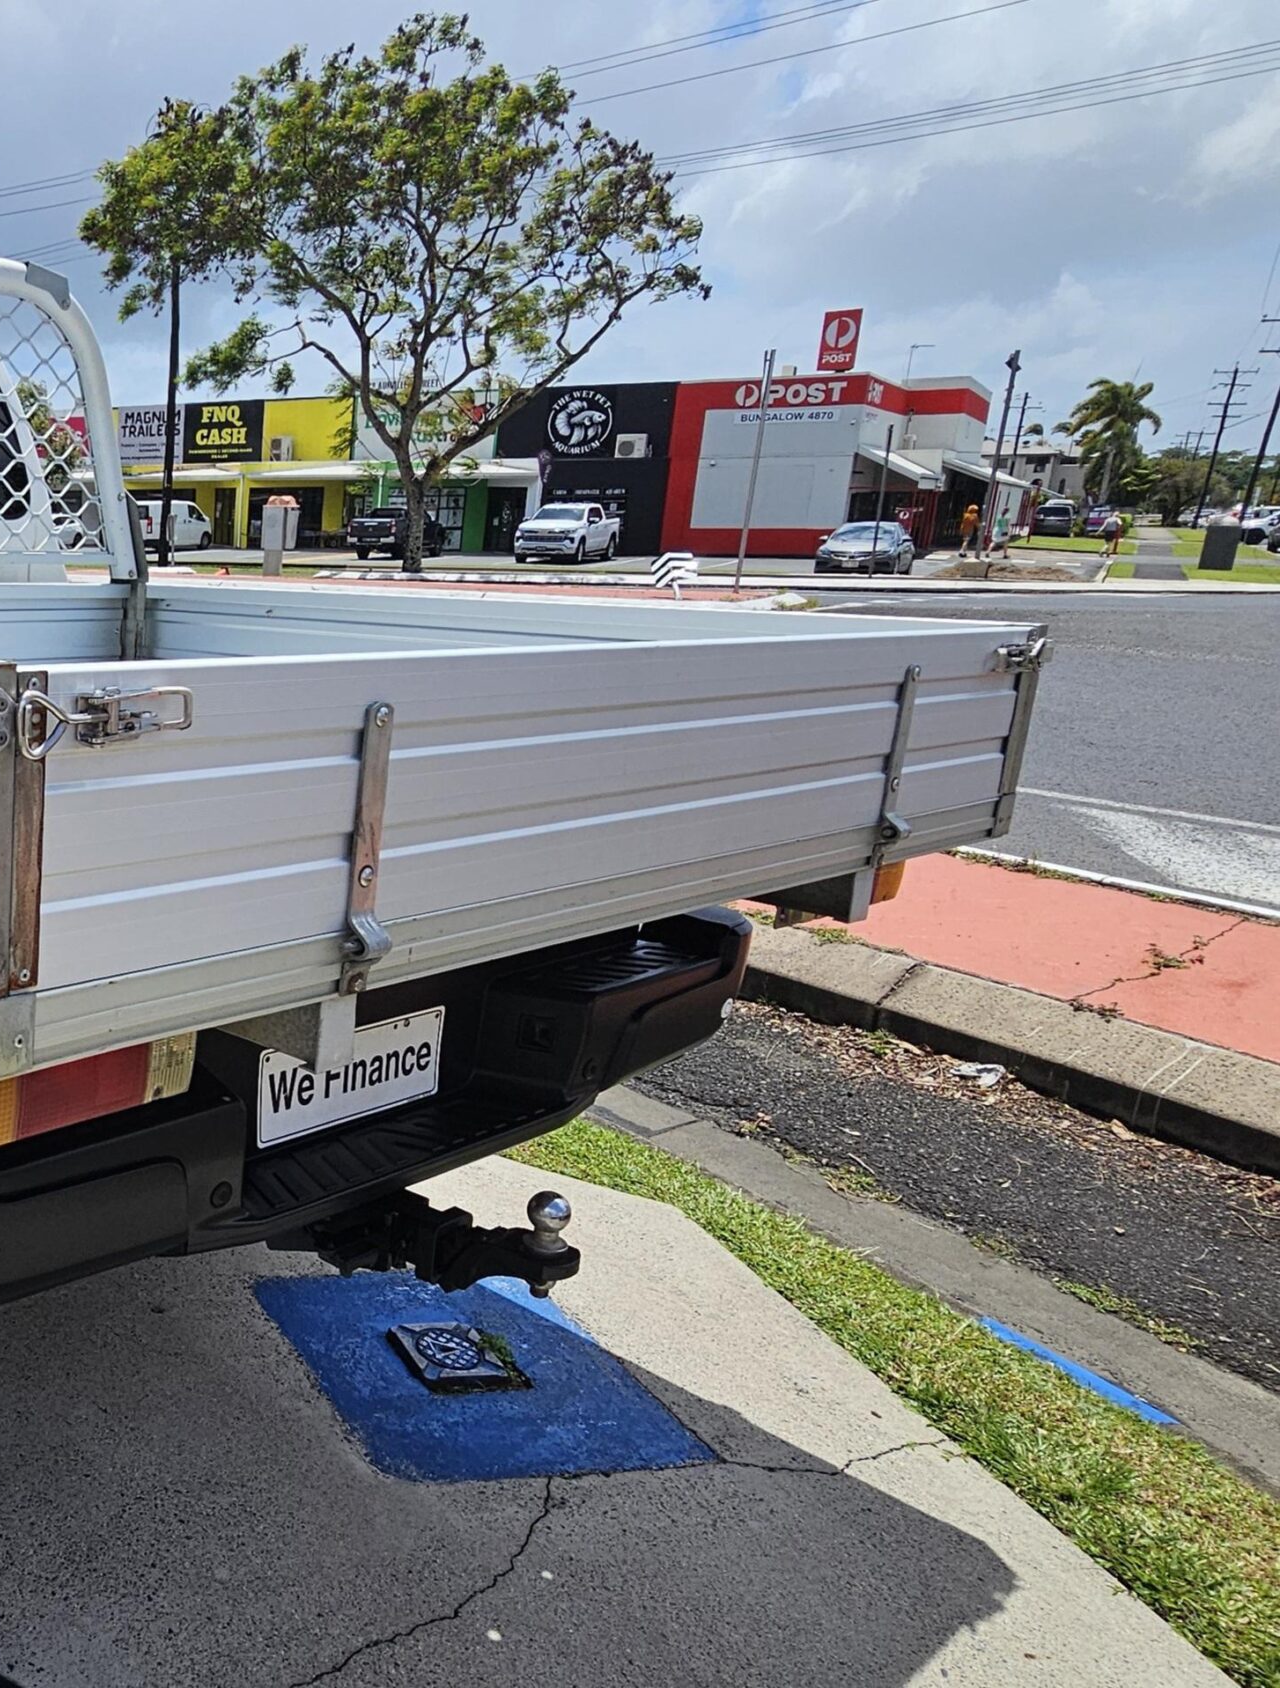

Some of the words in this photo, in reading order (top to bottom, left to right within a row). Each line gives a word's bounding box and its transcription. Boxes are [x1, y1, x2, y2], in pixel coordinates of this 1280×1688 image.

[822, 352, 852, 364] POST
[552, 393, 571, 410] THE
[572, 390, 595, 399] WET
[594, 393, 611, 408] PET
[769, 380, 848, 405] POST
[201, 405, 243, 427] FNQ
[807, 411, 834, 421] 4870
[195, 427, 247, 446] CASH
[552, 440, 601, 455] AQUARIUM
[269, 1066, 315, 1114] We
[324, 1041, 432, 1099] Finance
